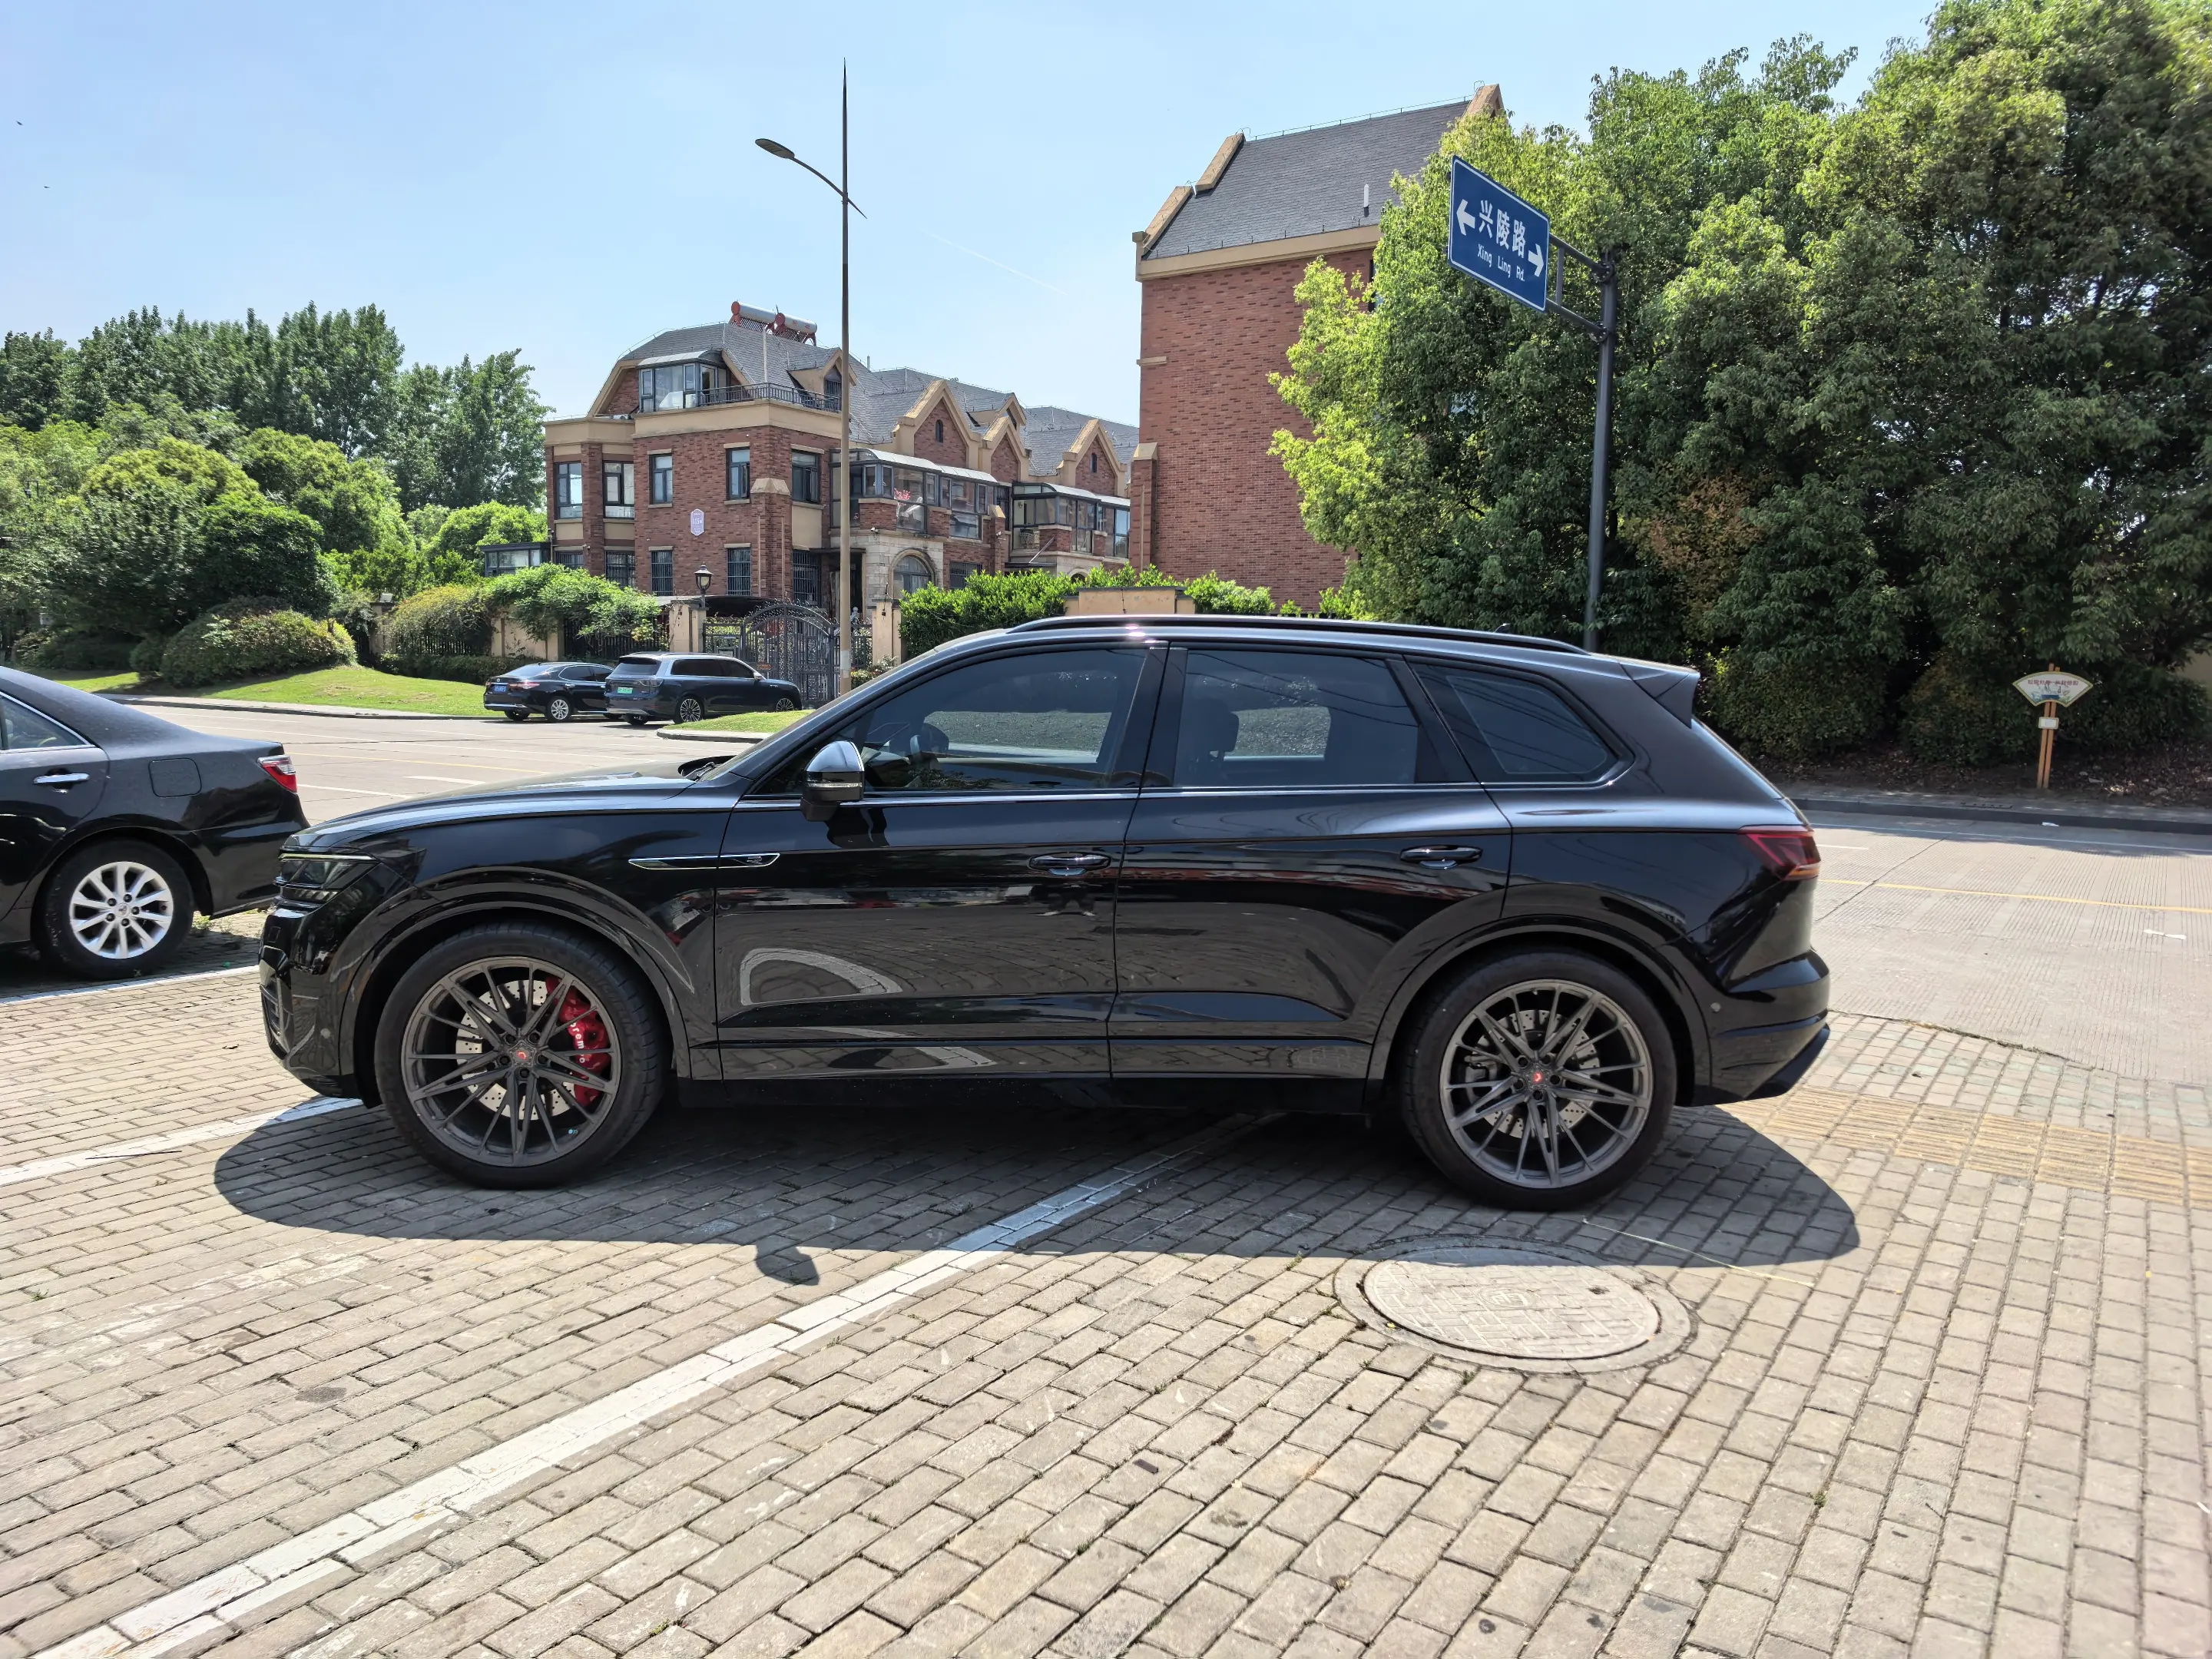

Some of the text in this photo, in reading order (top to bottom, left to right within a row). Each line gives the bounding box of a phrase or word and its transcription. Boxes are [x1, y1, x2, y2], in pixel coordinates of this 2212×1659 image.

[1479, 200, 1526, 259] 兴陵路
[1477, 243, 1492, 267] Xing
[1498, 256, 1511, 278] Ling
